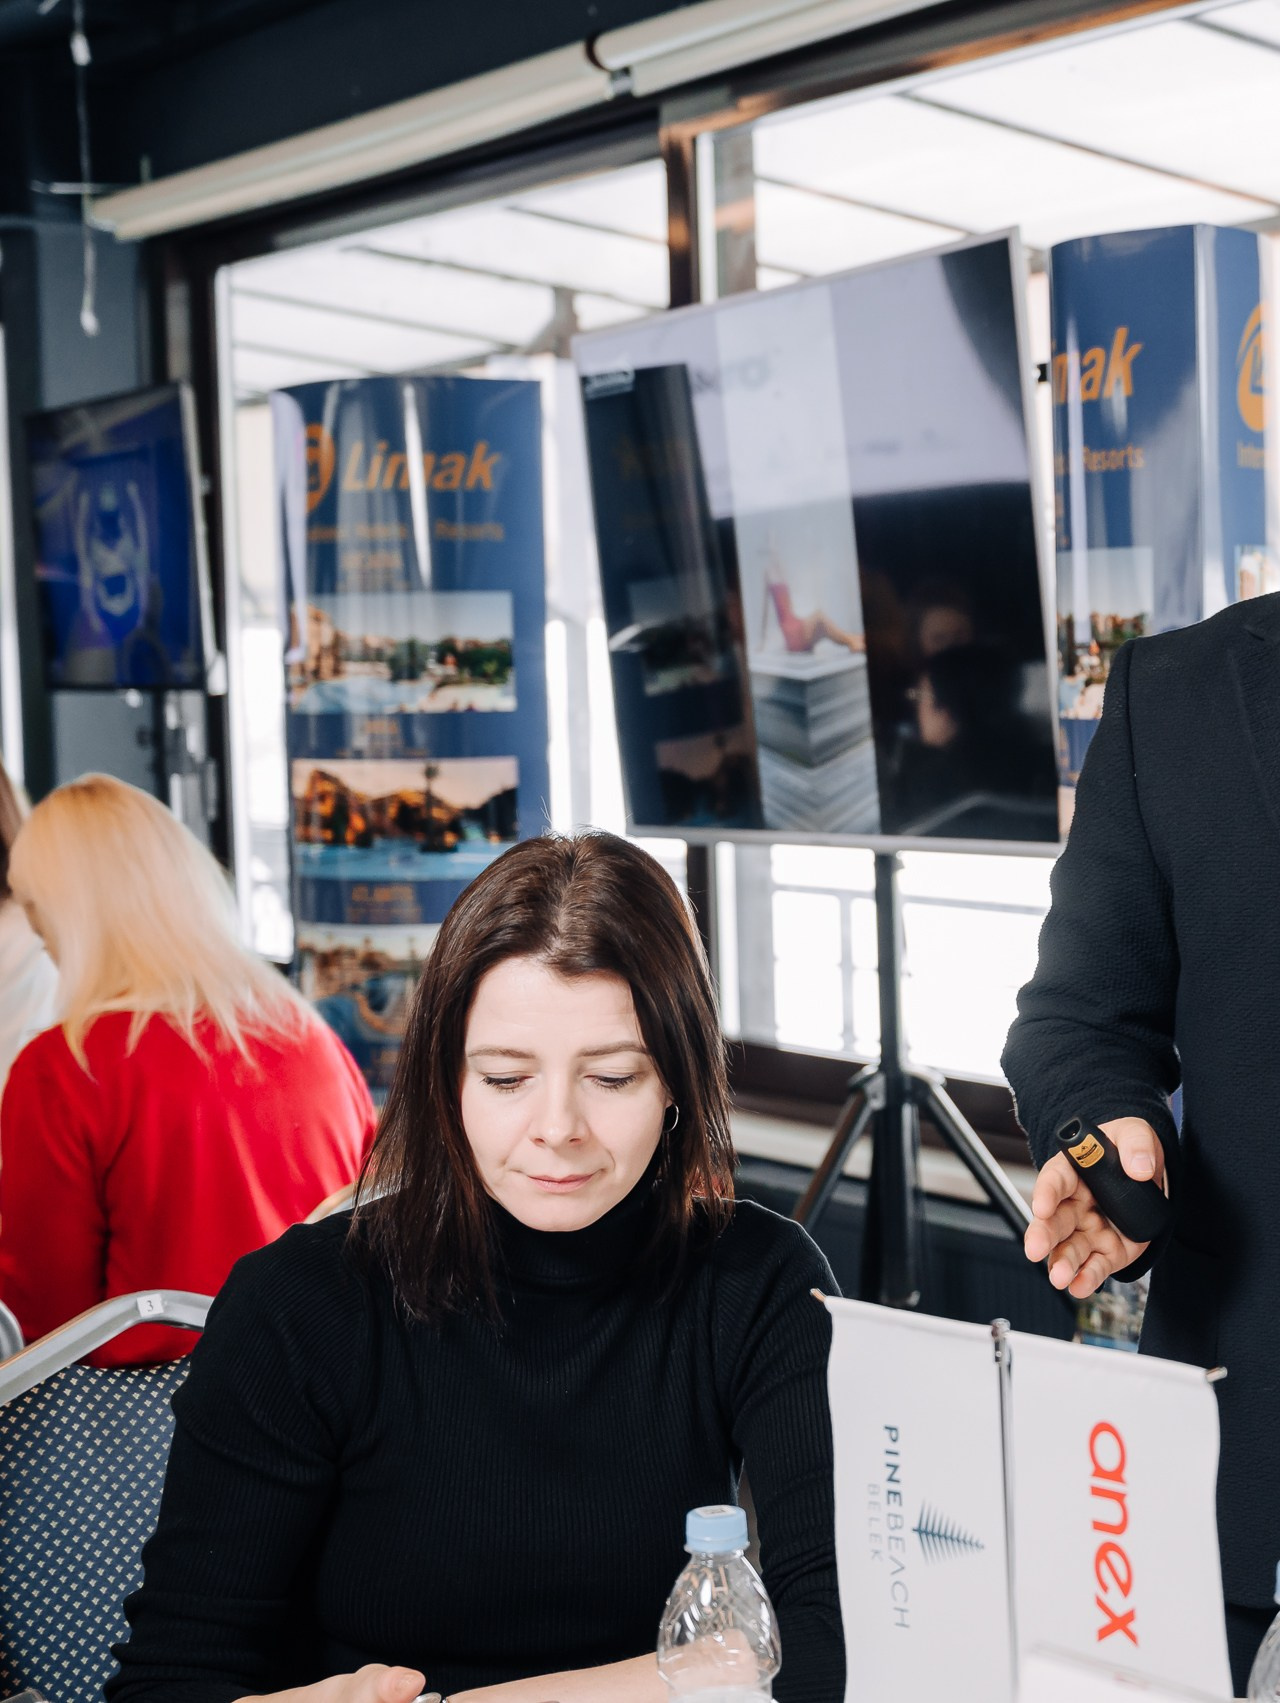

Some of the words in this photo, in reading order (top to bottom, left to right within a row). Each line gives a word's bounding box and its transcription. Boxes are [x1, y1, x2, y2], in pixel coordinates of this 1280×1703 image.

[1053, 327, 1144, 403] mak
[342, 441, 500, 490] Limak
[145, 1300, 154, 1313] 3
[867, 1483, 883, 1562] BELEK
[1089, 1421, 1139, 1648] anex
